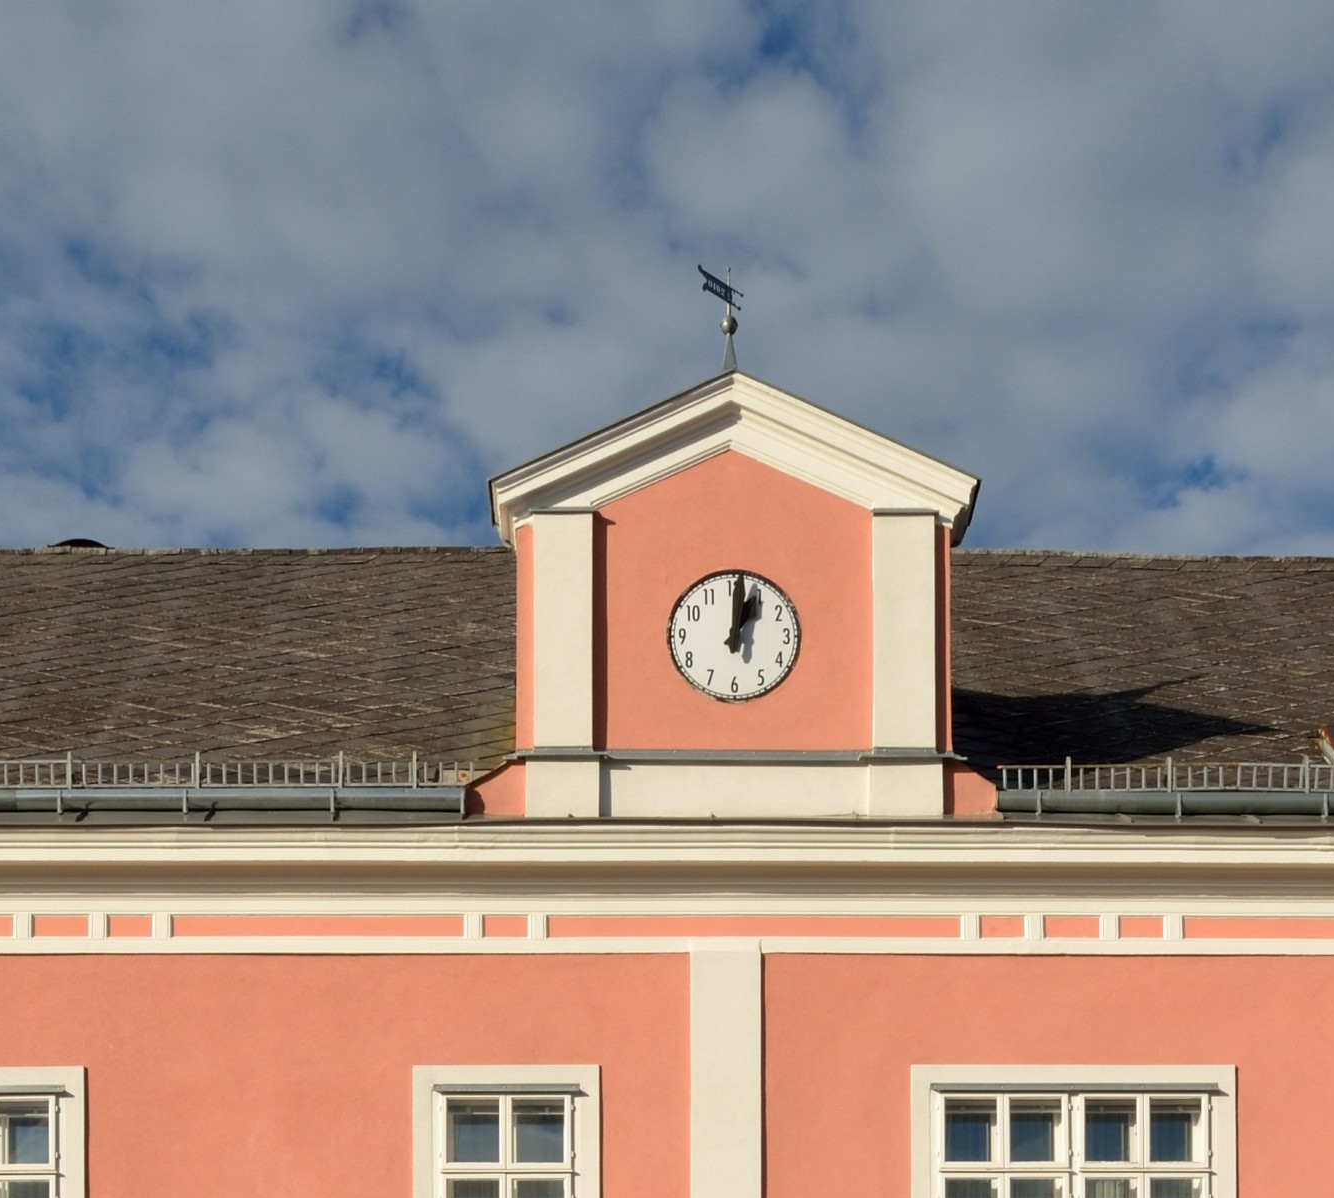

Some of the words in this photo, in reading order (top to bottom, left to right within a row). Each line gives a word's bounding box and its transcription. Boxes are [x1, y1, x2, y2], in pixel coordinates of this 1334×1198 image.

[703, 588, 715, 605] 11
[686, 605, 701, 622] 10
[774, 605, 783, 622] 2
[678, 628, 687, 645] 9
[782, 628, 791, 645] 3
[685, 651, 694, 668] 8
[775, 651, 784, 668] 4
[706, 669, 715, 686] 7
[730, 676, 739, 693] 6
[757, 669, 766, 686] 5
